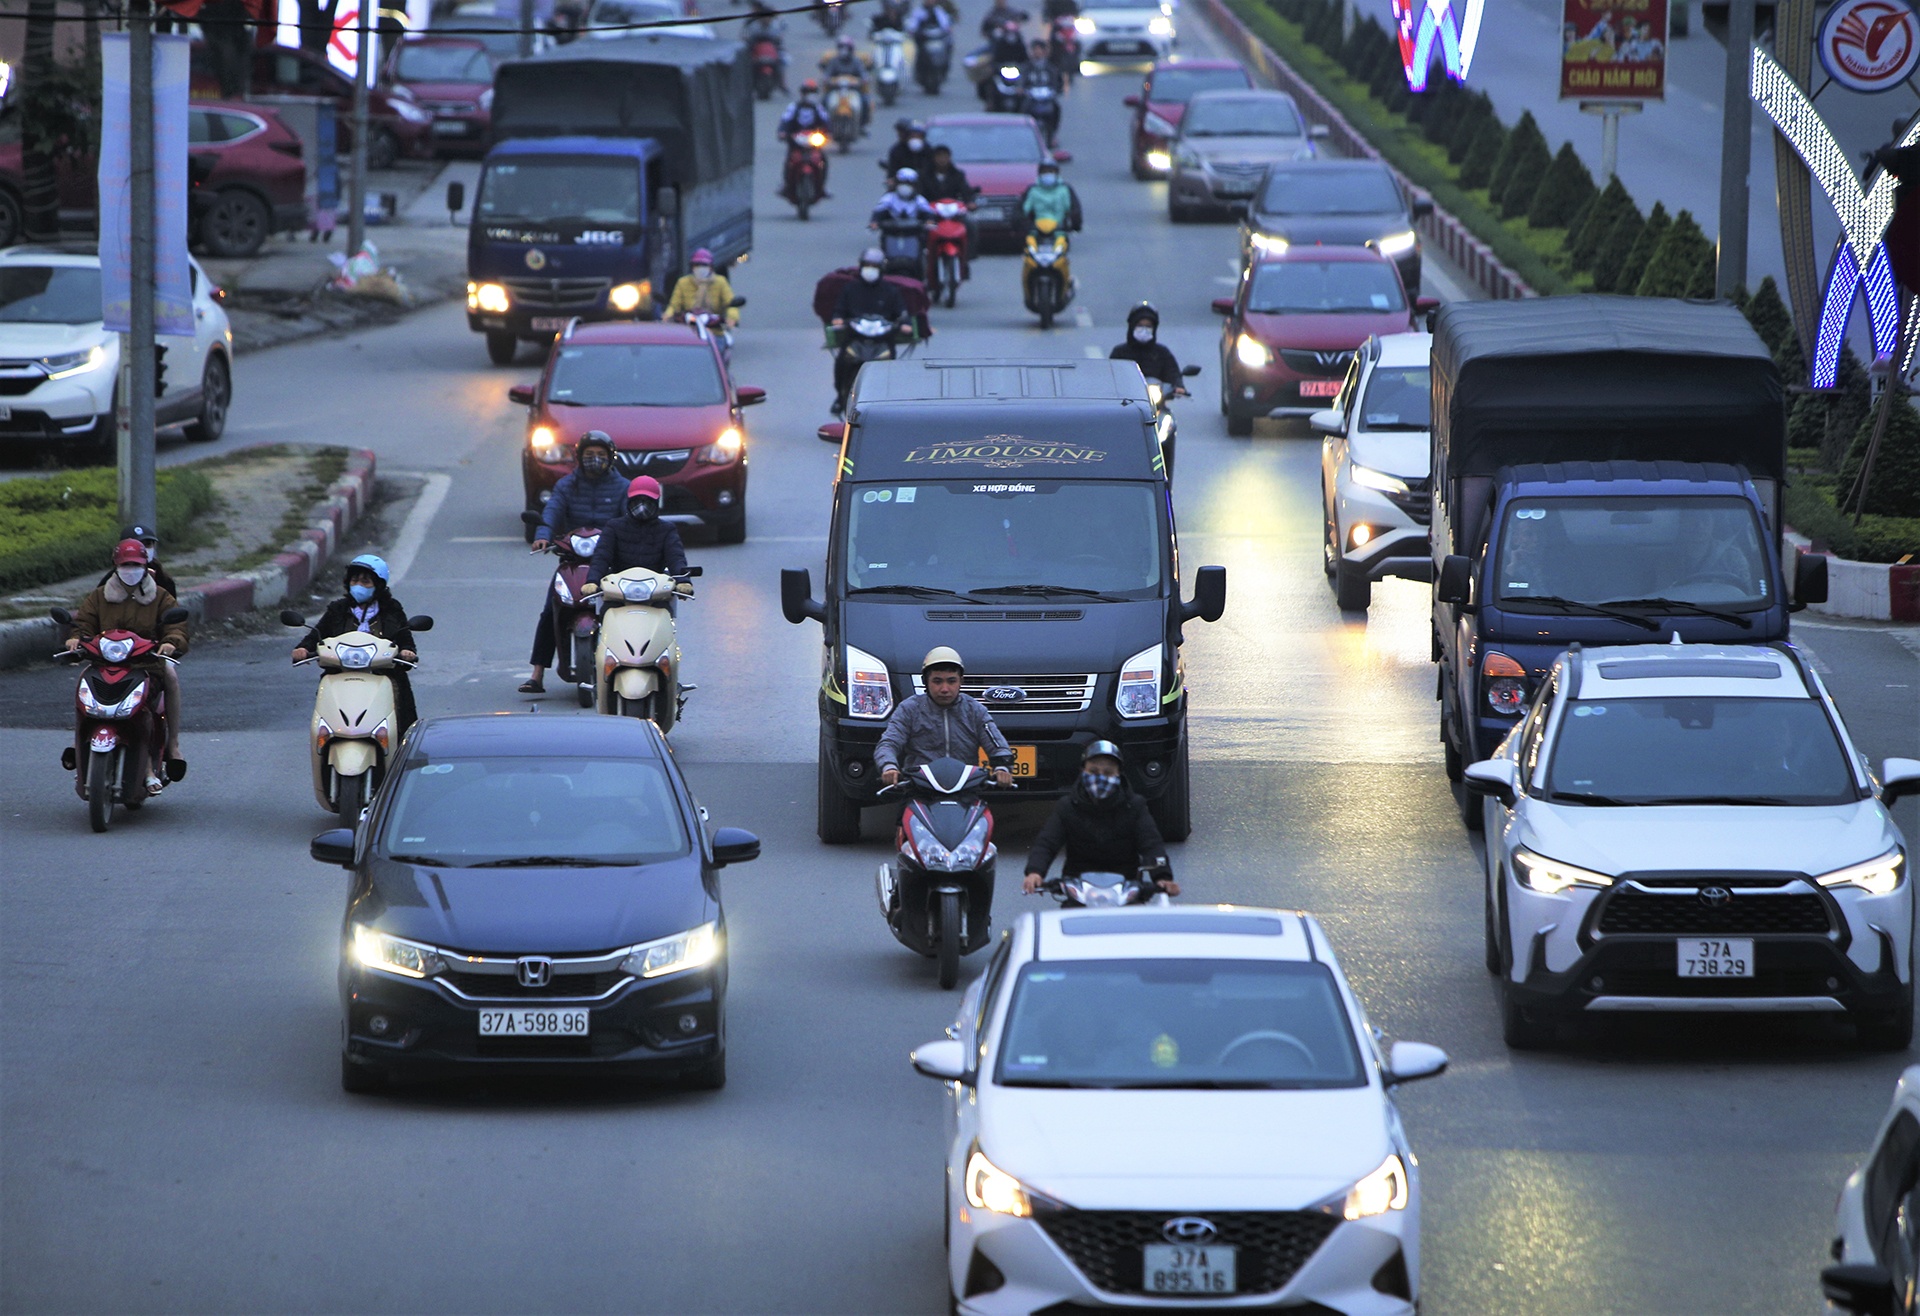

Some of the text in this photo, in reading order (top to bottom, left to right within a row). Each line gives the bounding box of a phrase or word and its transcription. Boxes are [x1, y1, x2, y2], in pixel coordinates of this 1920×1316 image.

[903, 446, 1108, 462] LIMOUSINE
[992, 689, 1017, 699] Ford
[1699, 942, 1731, 957] 37A
[1685, 959, 1745, 975] 738.29
[482, 1013, 585, 1033] 37A-598.96
[1171, 1247, 1209, 1268] 37A
